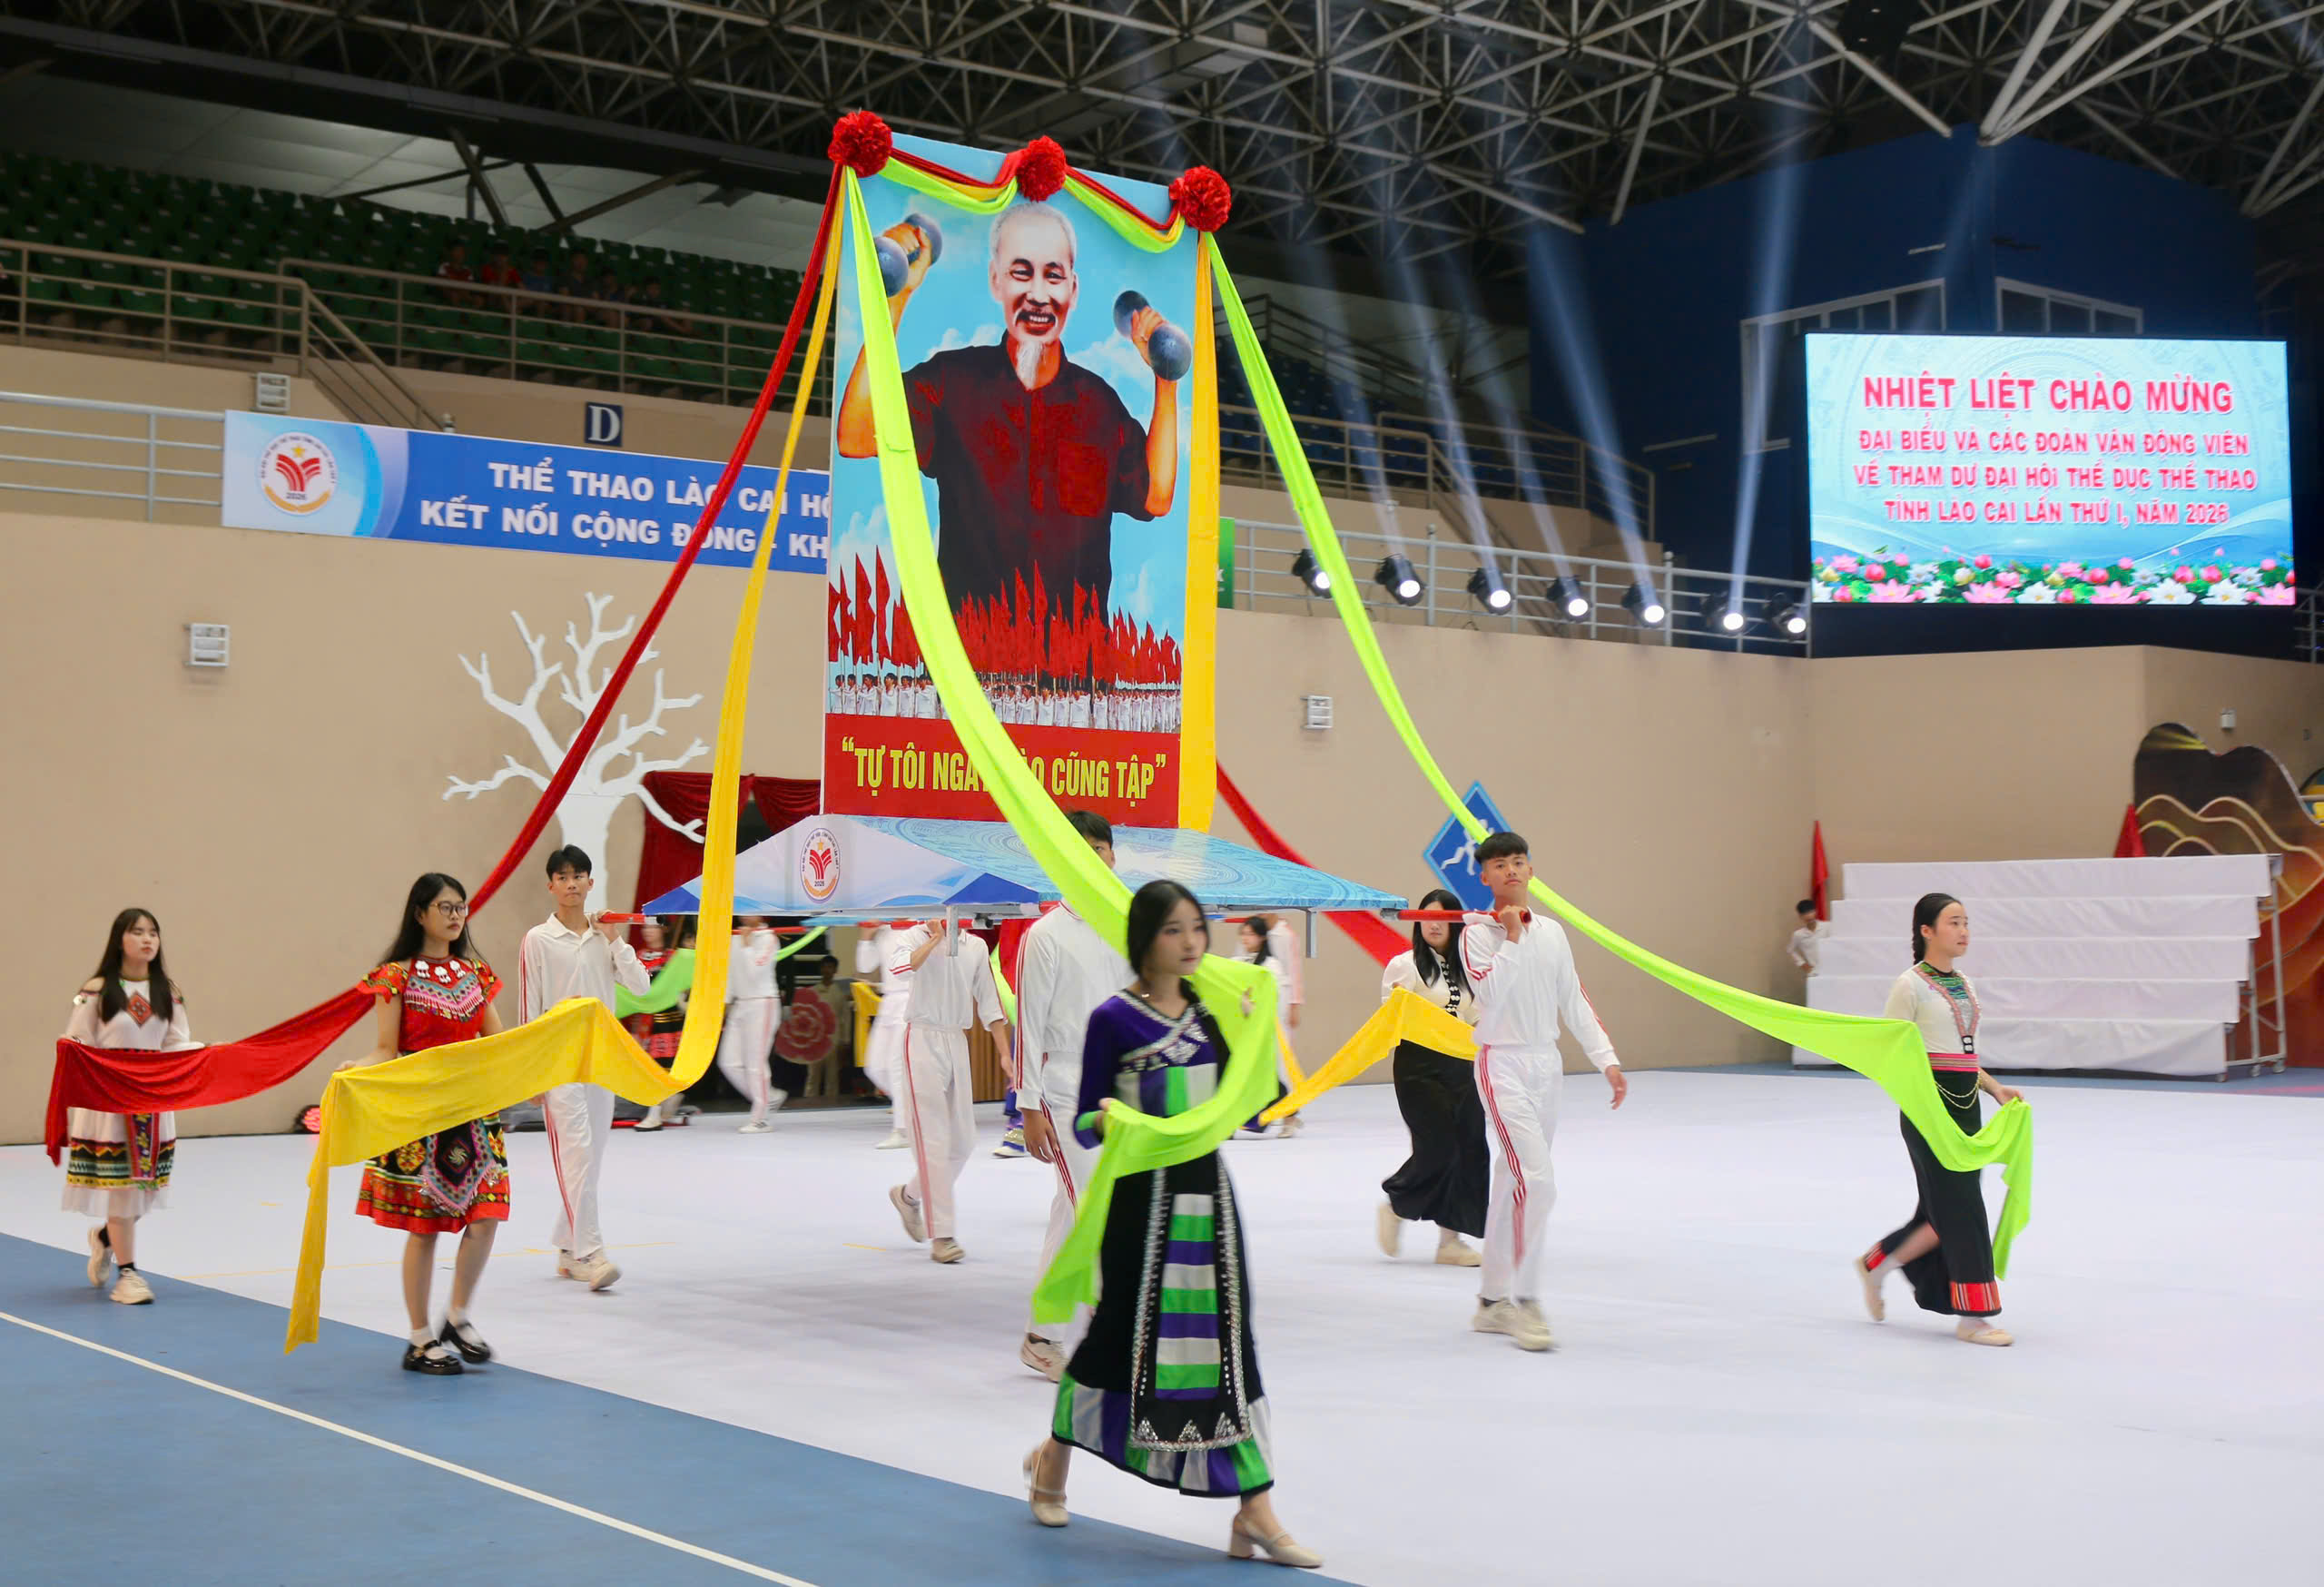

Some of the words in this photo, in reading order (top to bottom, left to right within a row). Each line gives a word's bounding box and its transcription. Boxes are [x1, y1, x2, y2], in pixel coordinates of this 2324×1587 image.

[1864, 370, 1955, 418] NHIỆT
[1969, 371, 2035, 419] LIỆT
[2050, 372, 2132, 411] CHÀO
[2145, 373, 2233, 413] MỪNG
[588, 405, 620, 442] D
[487, 457, 554, 492] THỂ
[566, 470, 655, 501] THAO
[1888, 465, 1944, 487] THAM
[2204, 468, 2258, 490] THAO
[420, 495, 489, 529] KẾT
[502, 502, 558, 537] NỐI
[572, 510, 660, 547] CỘNG
[1984, 500, 2017, 522] CAI
[890, 742, 926, 790] TÔI
[1052, 751, 1109, 798] CŨNG
